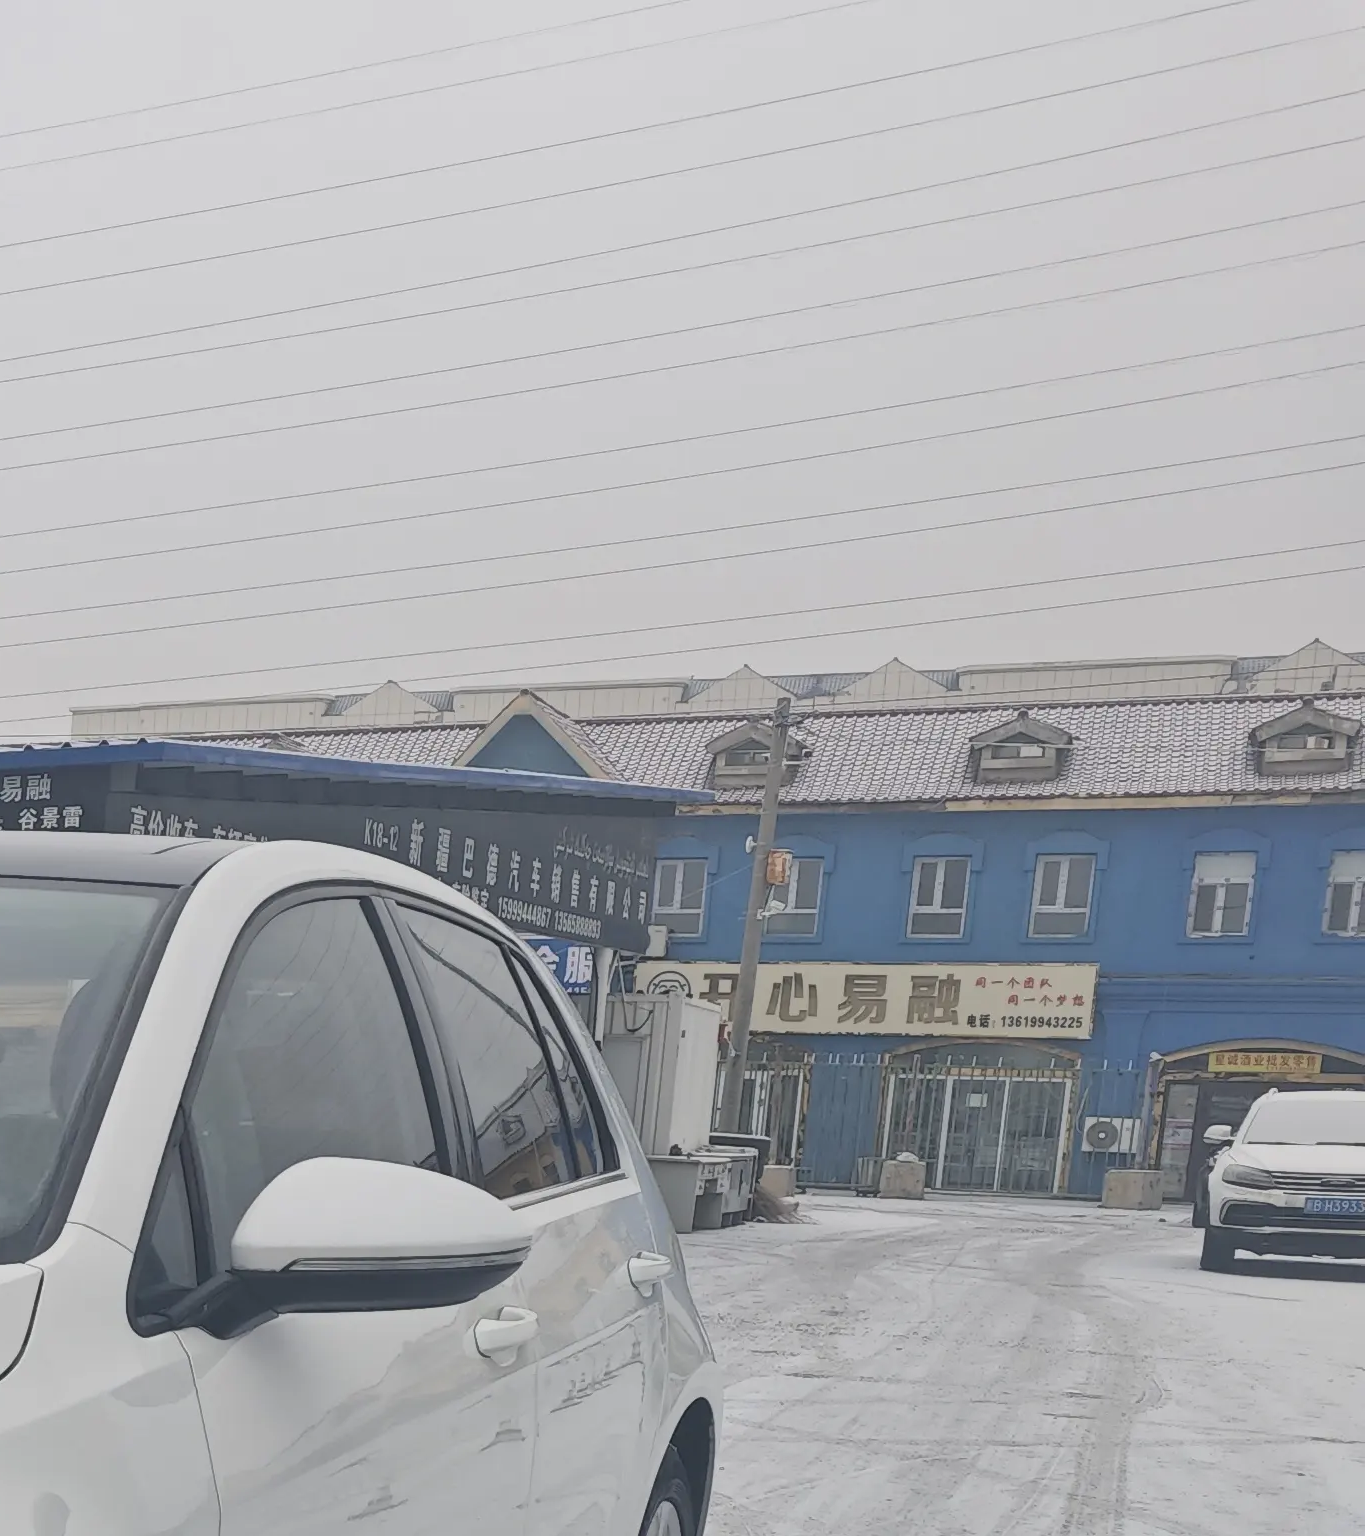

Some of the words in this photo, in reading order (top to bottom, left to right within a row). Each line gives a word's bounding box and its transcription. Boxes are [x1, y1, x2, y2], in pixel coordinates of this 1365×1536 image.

[18, 806, 83, 831] 谷景雷
[975, 976, 1054, 989] 同一个团队
[699, 972, 962, 1025] 开心易融
[1007, 994, 1086, 1008] 同一个梦想
